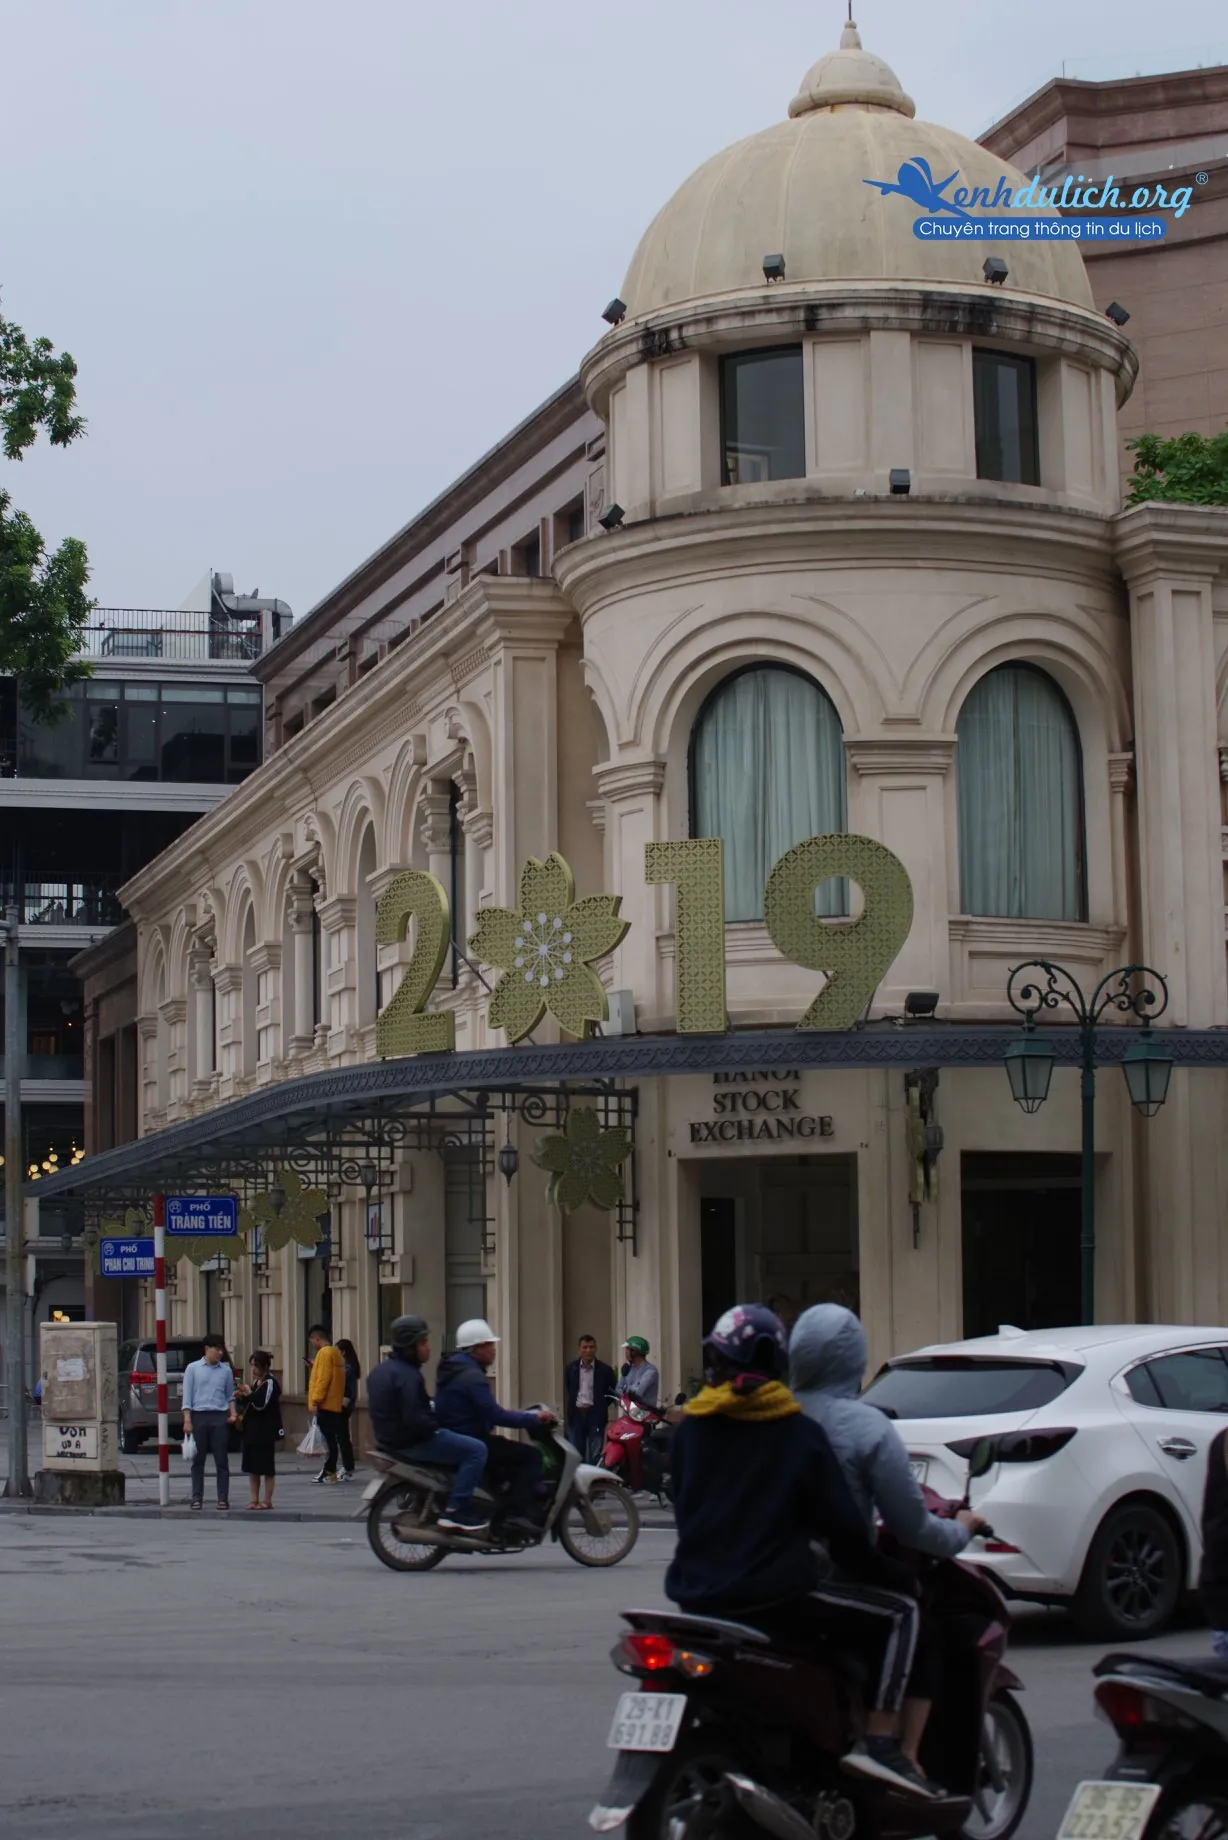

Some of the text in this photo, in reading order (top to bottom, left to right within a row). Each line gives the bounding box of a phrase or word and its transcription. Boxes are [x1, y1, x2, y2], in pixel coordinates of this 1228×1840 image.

[713, 1089, 801, 1114] STOCK
[688, 1115, 834, 1143] EXCHANGE
[189, 1200, 211, 1211] PHỐ
[120, 1243, 138, 1253] PHỐ
[104, 1257, 121, 1271] PHAN
[122, 1257, 135, 1271] CHU
